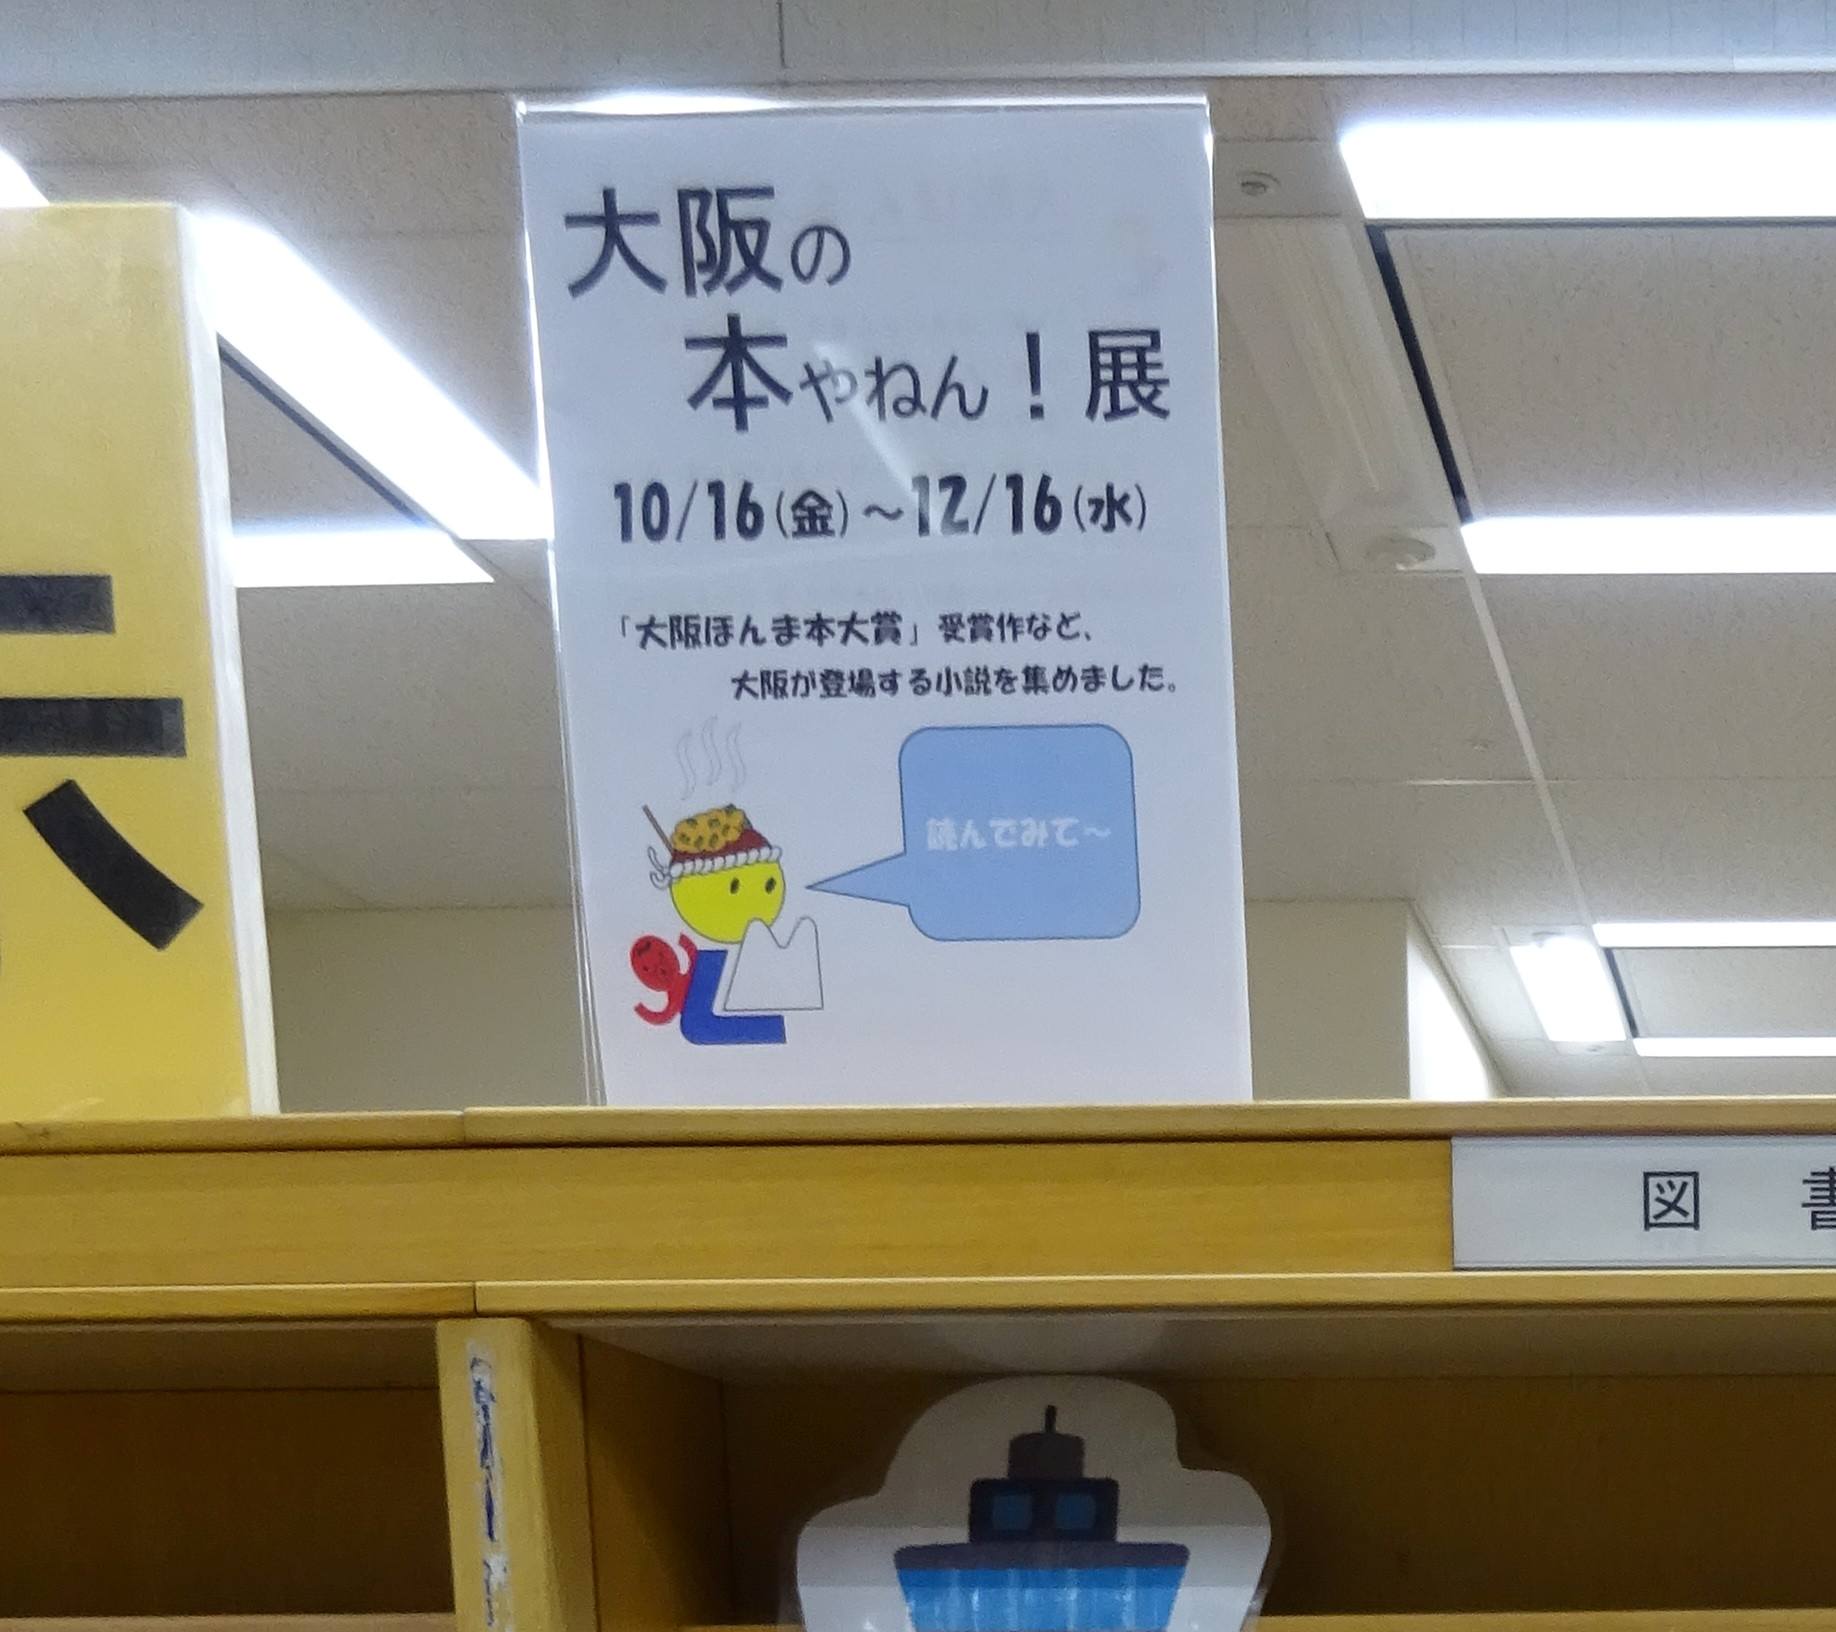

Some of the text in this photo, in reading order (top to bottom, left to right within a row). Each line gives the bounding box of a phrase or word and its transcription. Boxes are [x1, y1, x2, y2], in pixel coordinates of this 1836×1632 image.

[564, 184, 851, 299] 大阪の
[731, 663, 1177, 701] 大阪が登場する小説を集めました。
